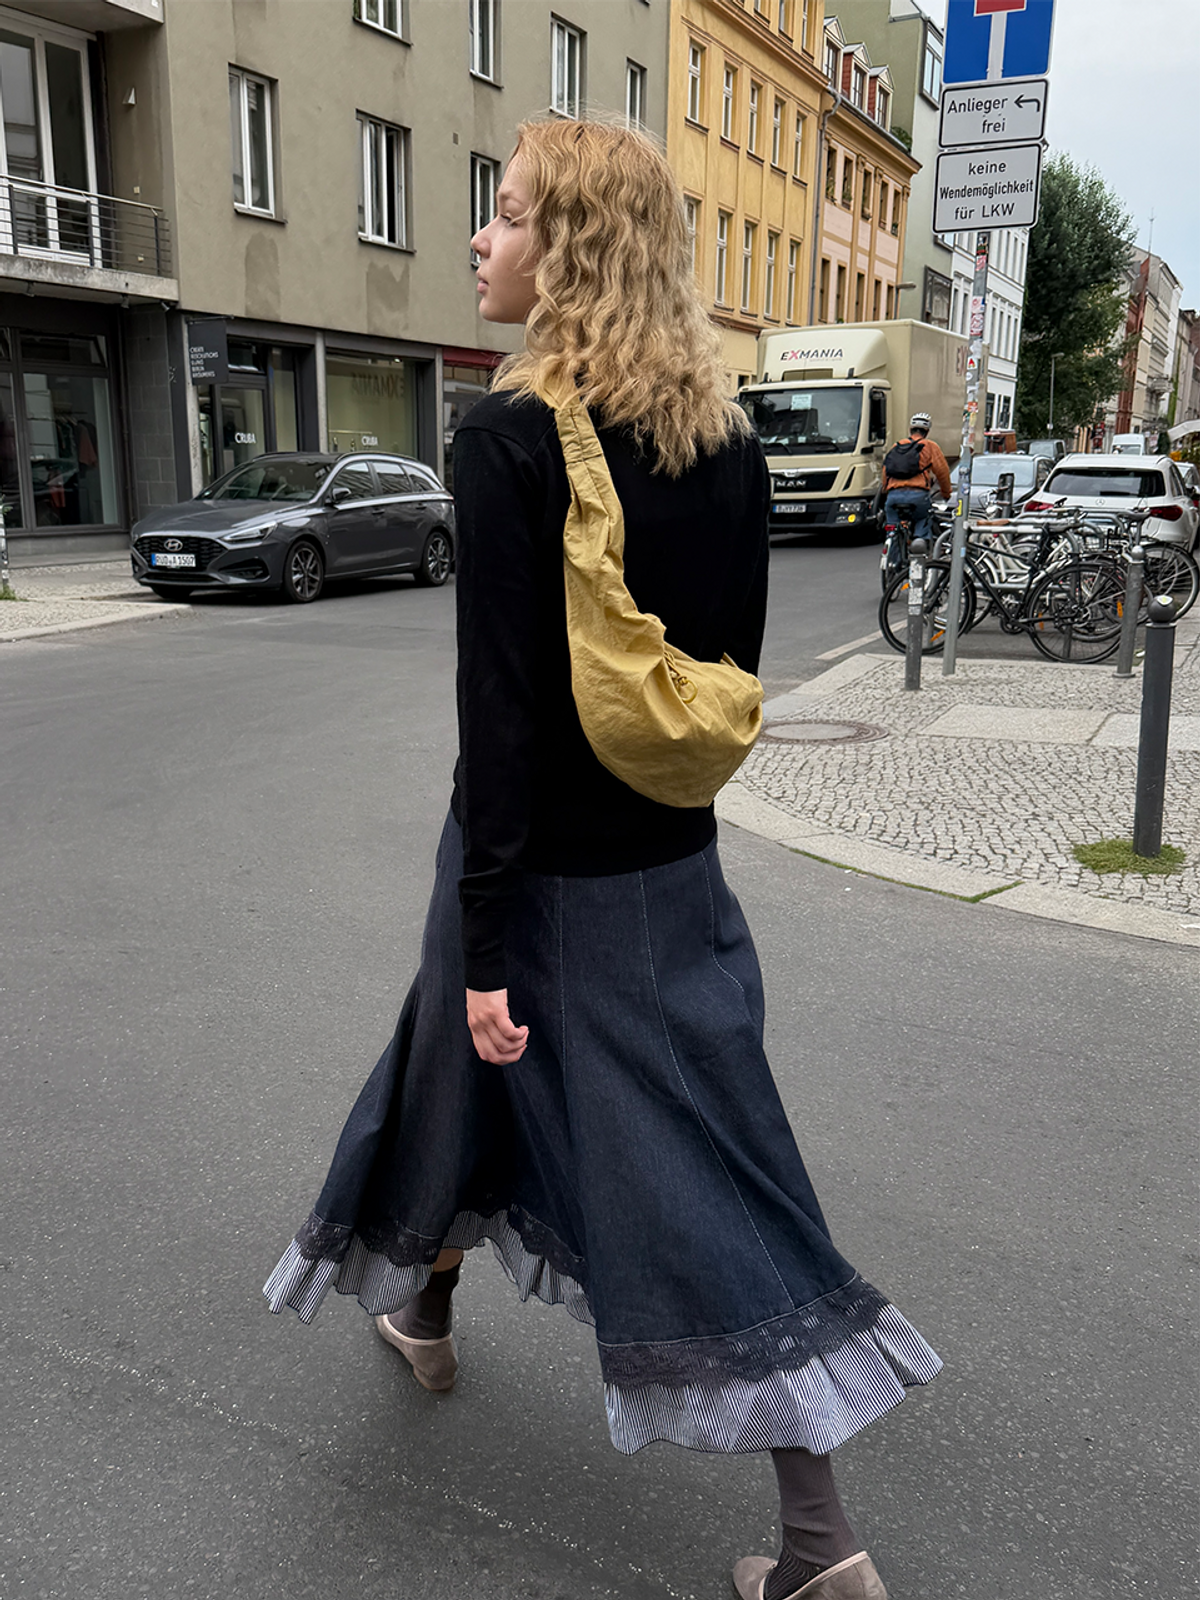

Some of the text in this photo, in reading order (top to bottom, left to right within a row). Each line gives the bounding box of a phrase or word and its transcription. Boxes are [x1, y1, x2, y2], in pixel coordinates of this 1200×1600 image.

[947, 98, 1008, 114] Anlieger
[982, 118, 1006, 134] frei
[968, 161, 1006, 175] keine
[940, 179, 1033, 199] Wendemöglichkeit
[955, 203, 1015, 220] für LKW
[780, 348, 843, 361] EXMANIA
